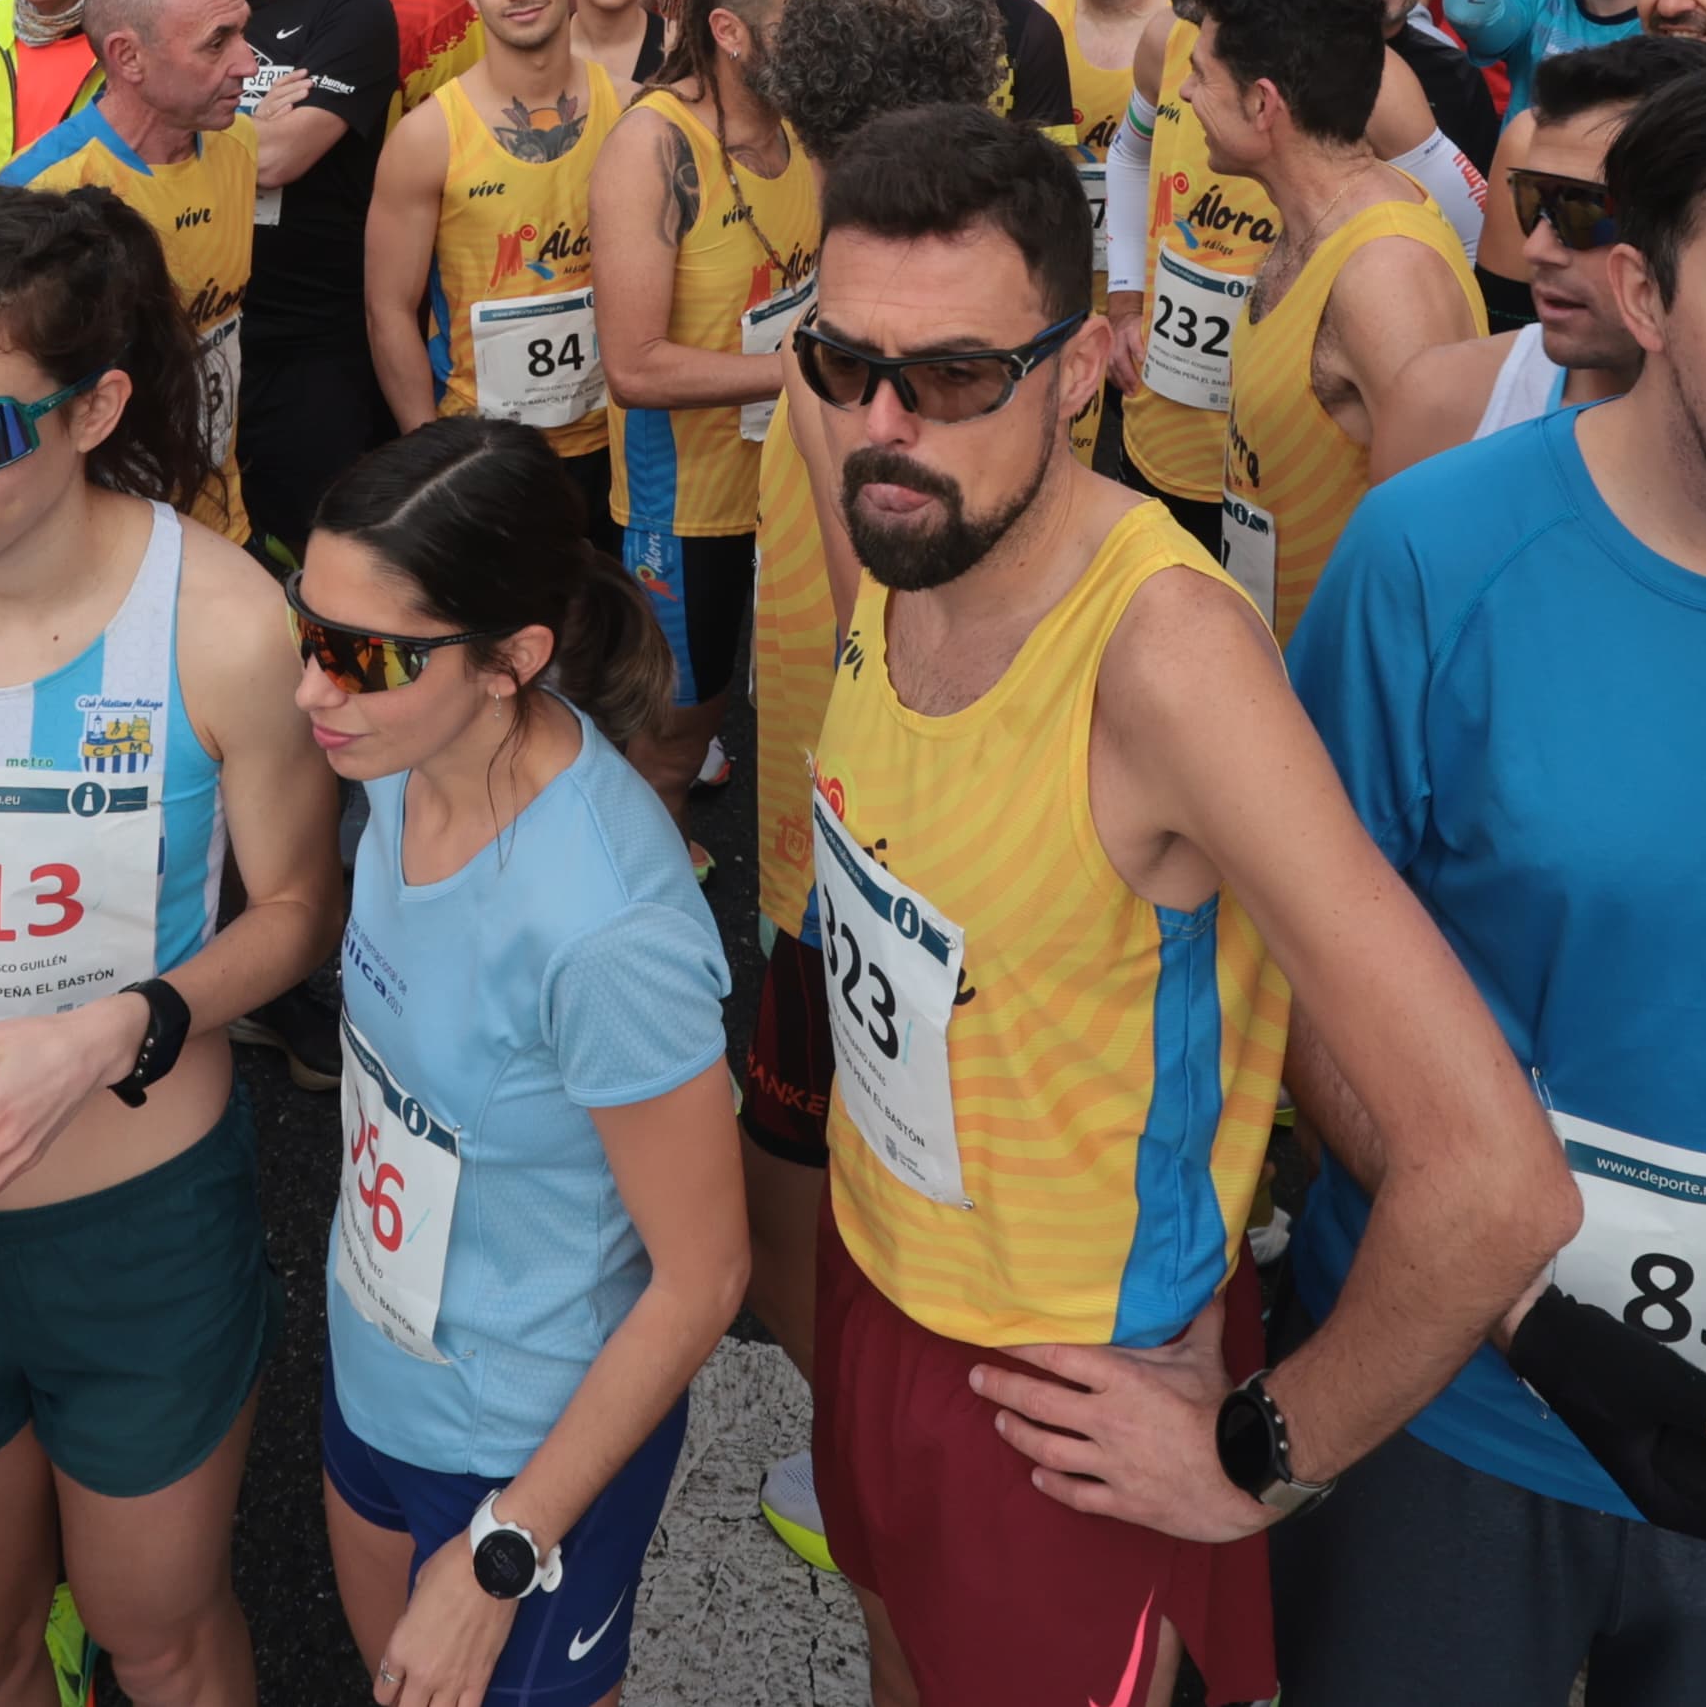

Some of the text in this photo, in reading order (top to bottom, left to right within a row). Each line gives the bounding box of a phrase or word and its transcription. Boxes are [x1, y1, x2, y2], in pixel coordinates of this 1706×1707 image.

[1189, 184, 1277, 244] Álora
[1153, 294, 1231, 358] 232
[526, 333, 586, 378] 84
[5, 756, 54, 768] metro
[92, 741, 143, 758] CAM
[19, 952, 68, 973] GUILLÉN
[35, 982, 54, 995] EL
[57, 967, 115, 992] BASTÓN
[872, 1090, 884, 1113] EL
[883, 1105, 926, 1148] BASTÓN
